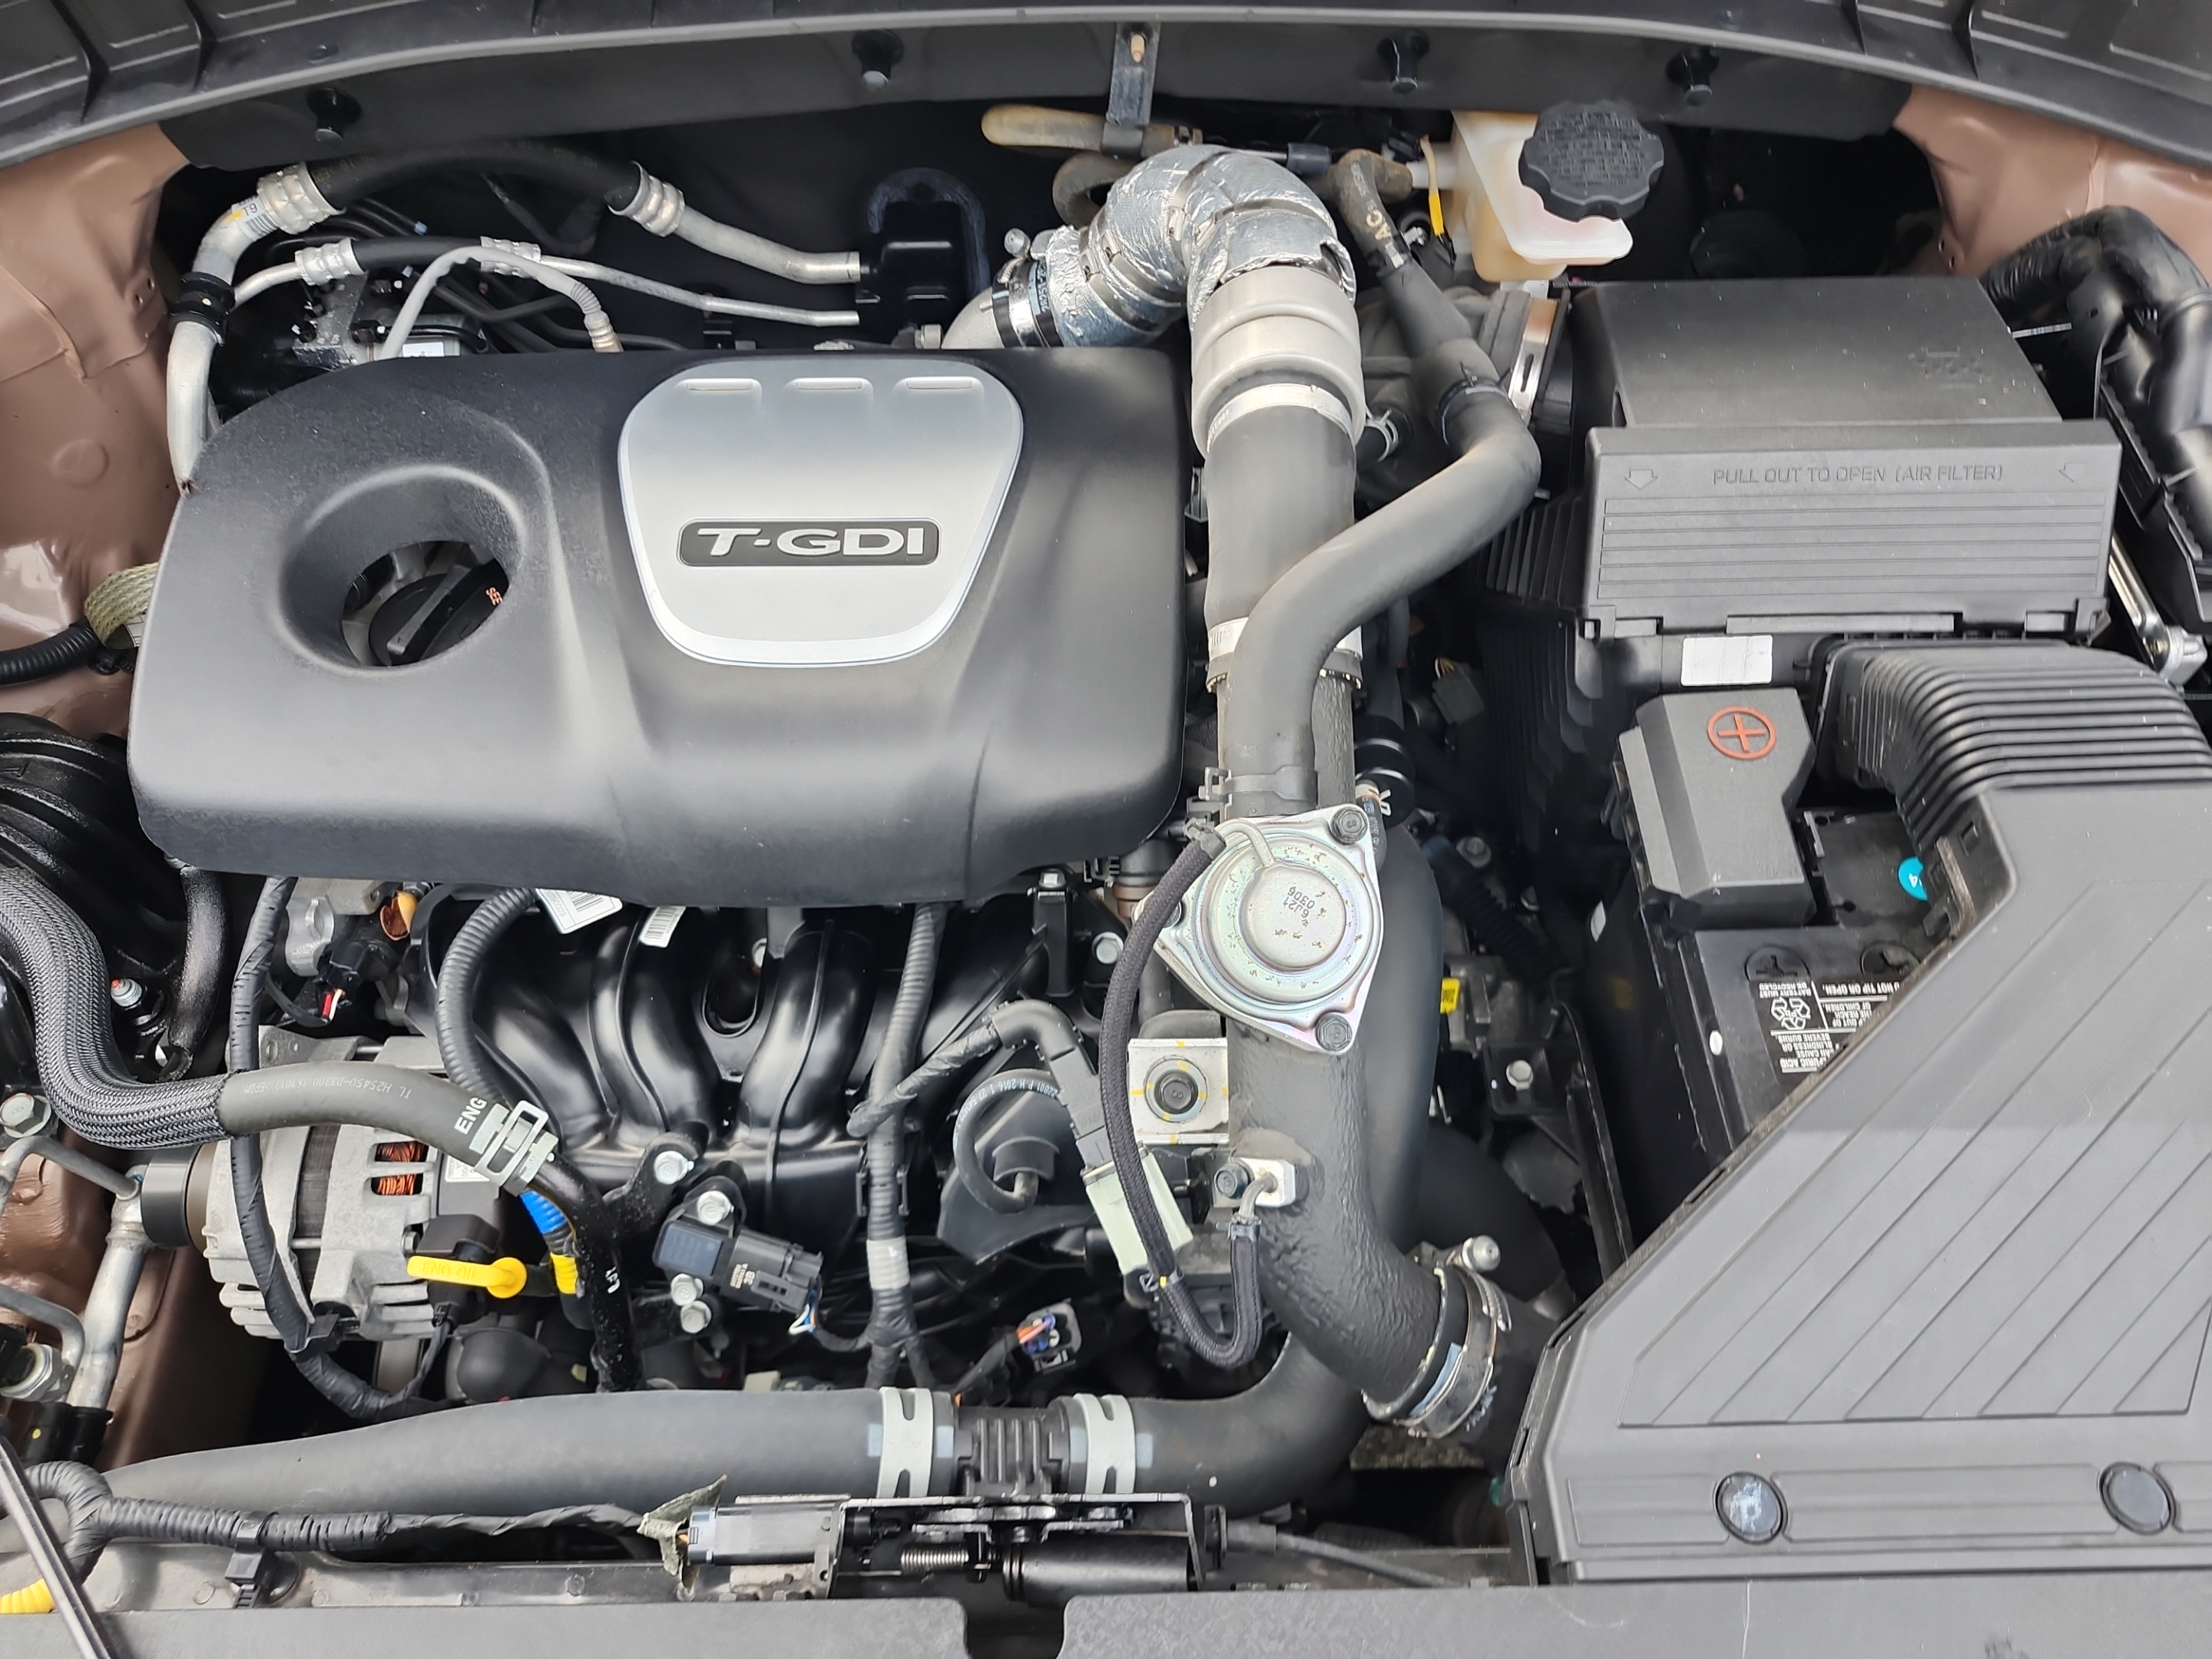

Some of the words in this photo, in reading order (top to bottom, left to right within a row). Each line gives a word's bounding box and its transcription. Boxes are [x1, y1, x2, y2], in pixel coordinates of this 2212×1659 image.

[1714, 469, 1759, 484] PULL
[1765, 468, 1802, 483] OUT
[1807, 467, 1830, 482] TO
[1836, 466, 1885, 481] OPEN
[1896, 465, 1932, 482] (AIR
[1938, 465, 2002, 481] FILTER)
[697, 528, 924, 557] T-GDI
[1759, 982, 1796, 991] RECYCLED
[1780, 988, 1811, 997] BATTERY
[1849, 983, 1862, 995] OR
[1863, 982, 1876, 994] TIP
[1877, 982, 1894, 994] NOT
[1759, 989, 1780, 998] MUST
[1862, 1002, 1871, 1010] OF
[1785, 1009, 1800, 1018] Pb
[1835, 1010, 1856, 1019] REACH
[1803, 1032, 1831, 1042] SEVERE
[1781, 1043, 1793, 1053] OR
[1793, 1041, 1833, 1051] BLINDNESS
[1796, 1049, 1818, 1059] CAUSE
[1780, 1057, 1800, 1068] ACID
[275, 1078, 307, 1091] 161013
[312, 1077, 392, 1094] H25450-D3300
[998, 1078, 1016, 1092] 2016
[1019, 1078, 1025, 1090] H
[399, 1085, 412, 1099] TL
[455, 1097, 487, 1135] ENG
[422, 1260, 450, 1276] ENG
[455, 1265, 478, 1280] OIL
